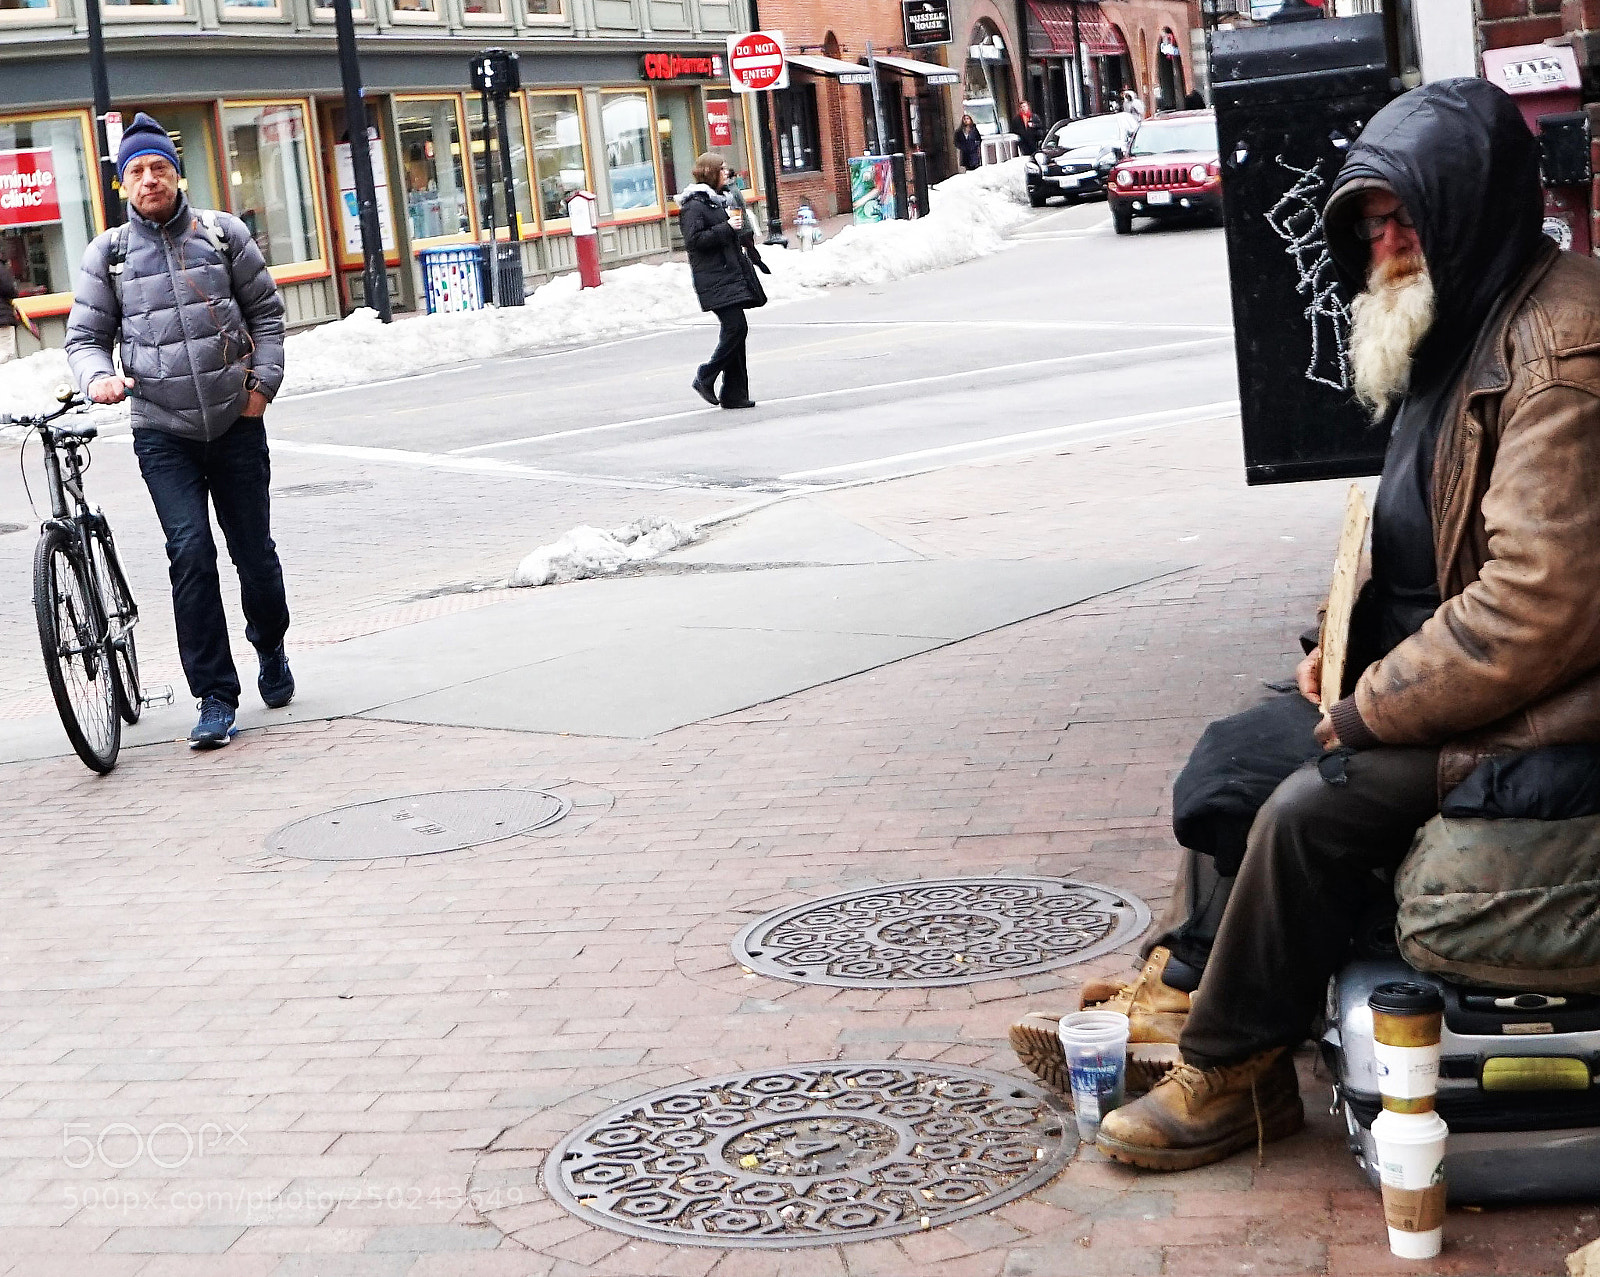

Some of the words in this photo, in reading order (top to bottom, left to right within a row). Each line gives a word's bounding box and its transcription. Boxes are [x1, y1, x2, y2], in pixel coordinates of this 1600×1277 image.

[908, 12, 946, 23] RUSSELL
[914, 21, 942, 30] HOUSE
[736, 46, 750, 55] DO
[754, 43, 775, 54] NOT
[742, 68, 774, 80] ENTER
[0, 168, 53, 189] minute
[1, 188, 43, 209] clinic
